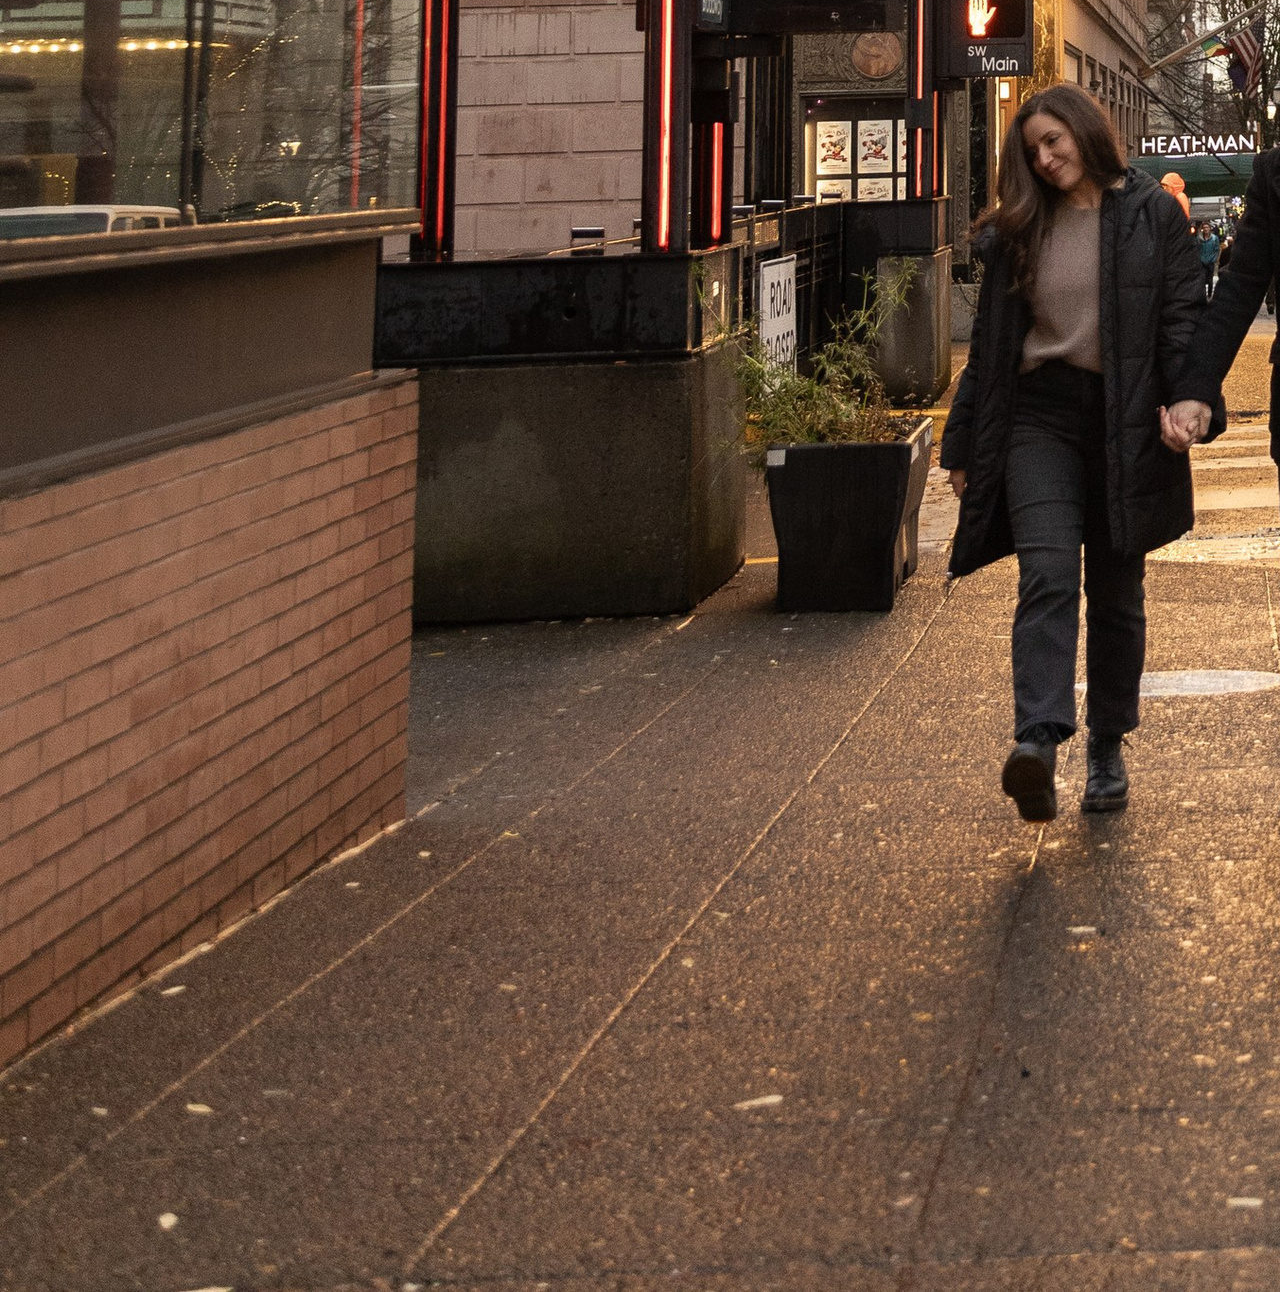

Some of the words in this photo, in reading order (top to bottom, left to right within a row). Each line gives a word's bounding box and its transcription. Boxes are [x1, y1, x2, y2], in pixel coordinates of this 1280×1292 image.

[967, 46, 987, 57] SW
[981, 57, 1019, 71] Main
[1141, 134, 1255, 154] HEATHMAN
[770, 277, 792, 319] ROAD
